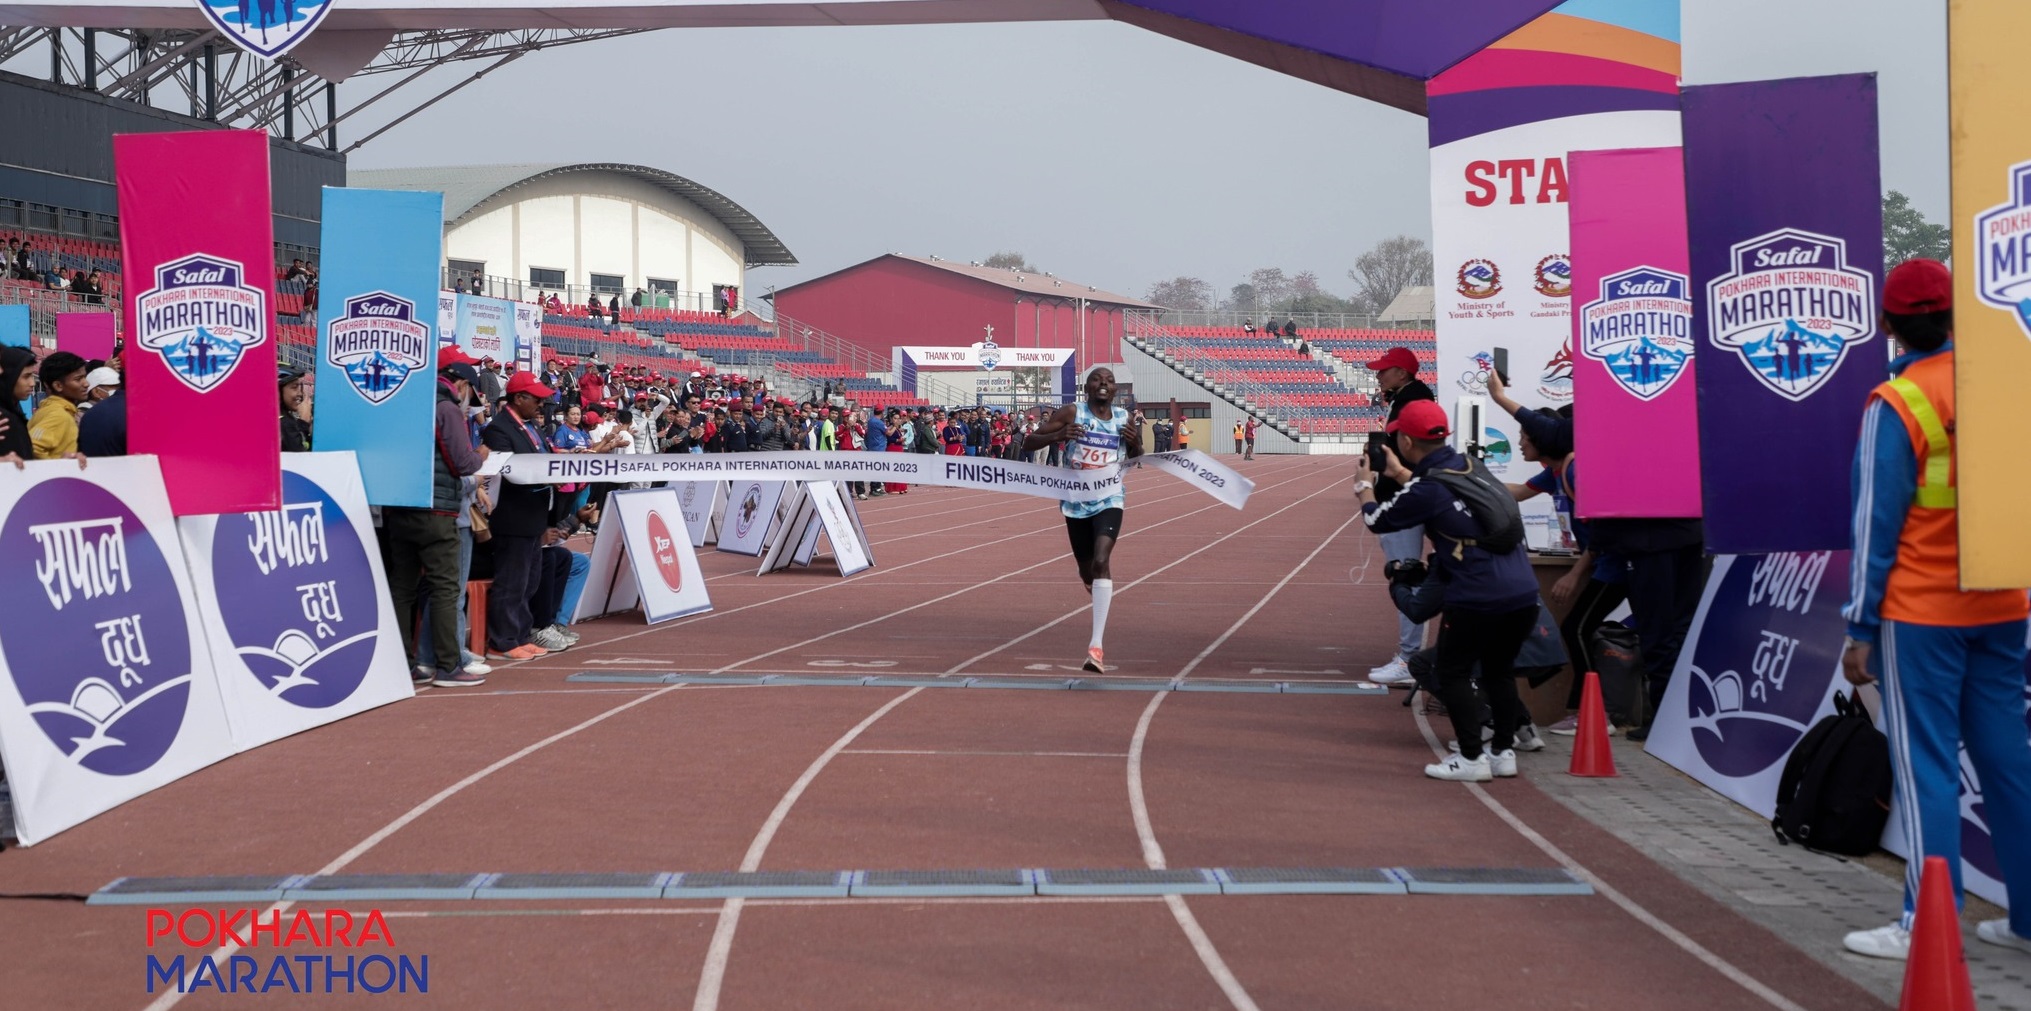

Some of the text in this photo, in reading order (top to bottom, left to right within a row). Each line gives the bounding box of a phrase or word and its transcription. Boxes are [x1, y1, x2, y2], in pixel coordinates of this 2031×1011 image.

[1464, 158, 1568, 207] STA
[1990, 211, 2031, 239] POKH
[1754, 245, 1823, 267] Safal
[173, 267, 226, 284] Safal
[1719, 271, 1861, 300] POKHARA INTERNATIONAL
[1617, 279, 1671, 295] Safal
[145, 288, 256, 310] POKHARA INTERNATIONAL
[358, 302, 402, 316] Safal
[1457, 301, 1505, 311] Ministry of
[146, 301, 256, 336] MARATHON
[1448, 309, 1514, 319] Youth & Sports
[1530, 310, 1560, 318] Gandaki
[1589, 299, 1693, 320] POKHARA INTERNATION
[1720, 287, 1862, 332] MARATHON
[213, 326, 234, 336] 2023
[334, 319, 423, 338] POKHARA INTERNATIONAL
[1590, 312, 1691, 345] MARATHO
[1806, 318, 1832, 330] 2023
[334, 329, 422, 359] MARATHON
[1656, 336, 1677, 346] 2023
[386, 351, 404, 360] 2023
[924, 351, 966, 361] THANK YOU
[1016, 352, 1055, 362] THANK YOU
[1082, 447, 1108, 463] 761
[499, 465, 512, 474] 23
[547, 459, 918, 477] FINISH SAFAL POKHARA INTERNATIONAL MARATHON 2023
[945, 462, 1006, 485] FINISH
[1007, 471, 1038, 486] SAFAL
[1041, 476, 1090, 491] POKHARA
[1198, 468, 1226, 488] 2023
[244, 500, 330, 575] सफल
[29, 515, 132, 610] सफल
[296, 580, 344, 640] दूध
[95, 614, 151, 688] दूध
[1750, 630, 1800, 703] दूध
